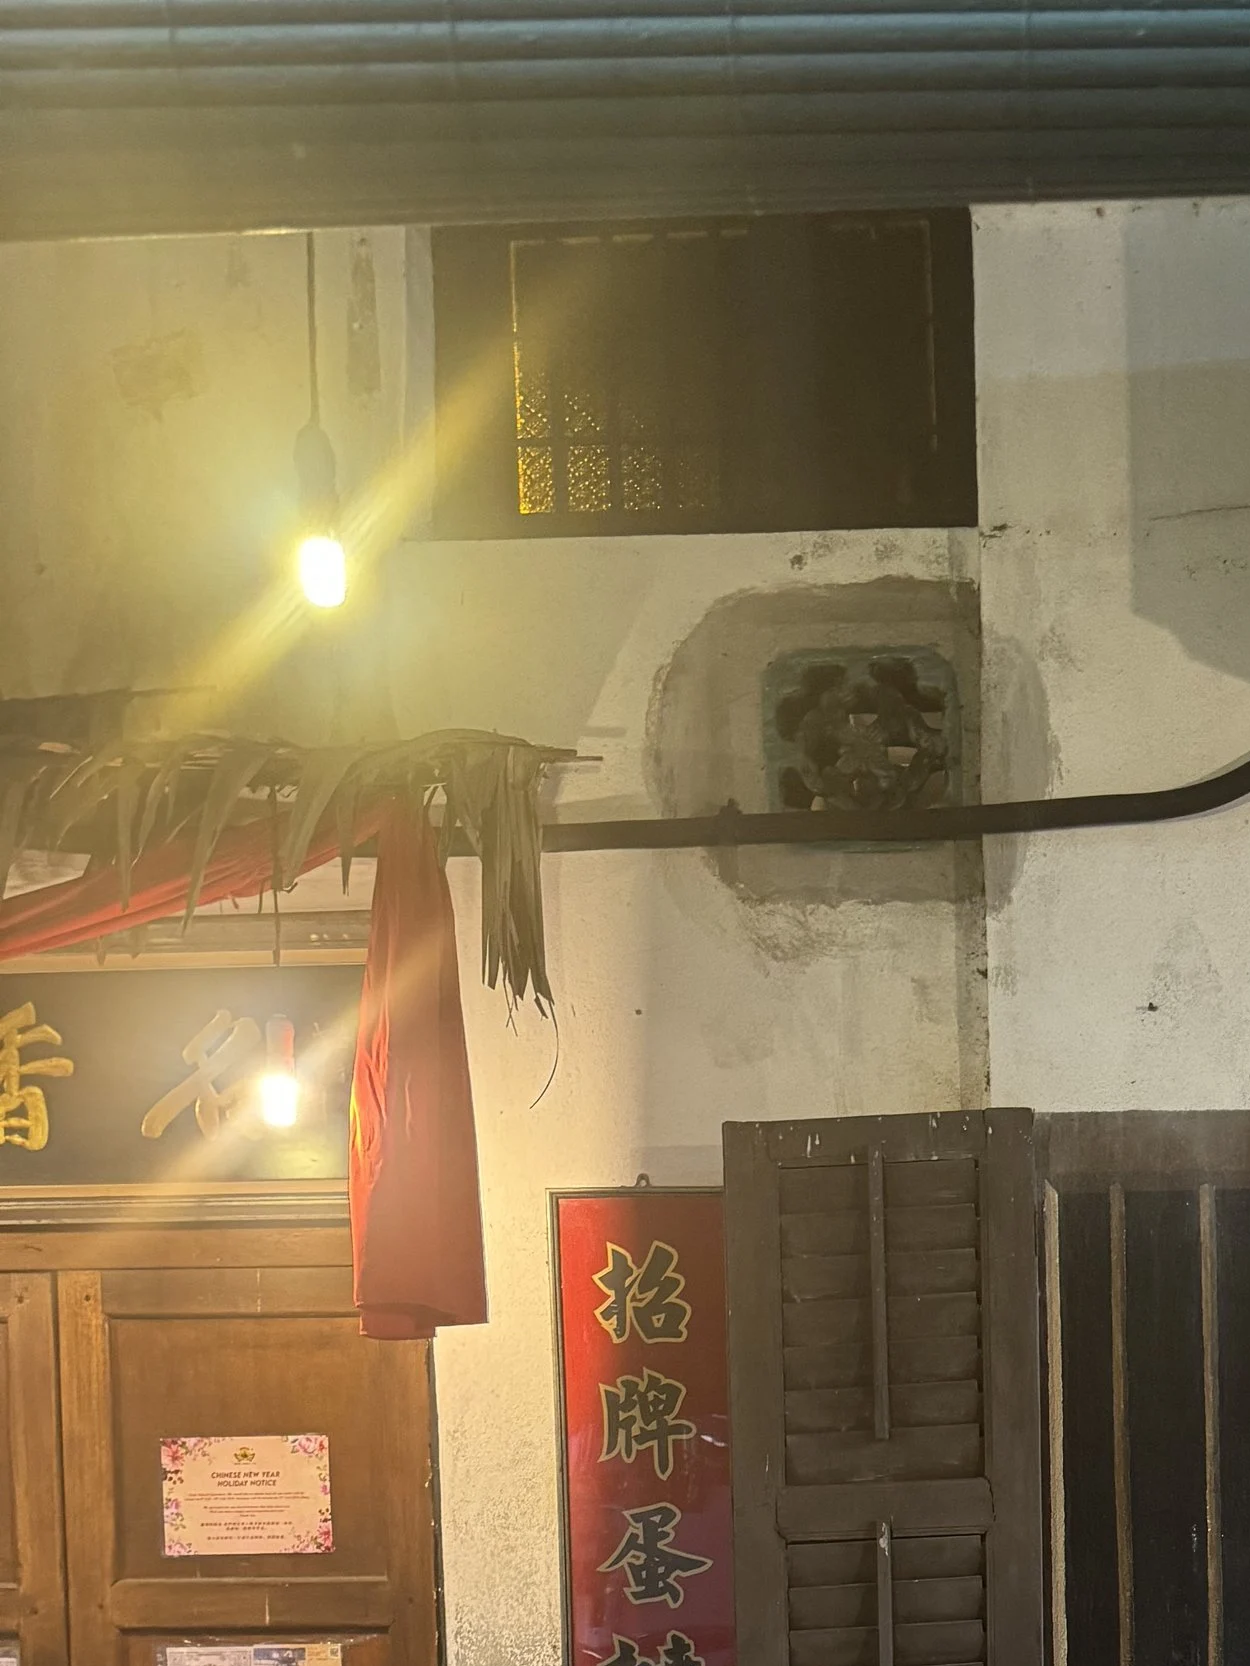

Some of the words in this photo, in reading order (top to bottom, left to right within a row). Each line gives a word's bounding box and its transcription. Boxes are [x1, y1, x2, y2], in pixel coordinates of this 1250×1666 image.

[210, 1471, 241, 1479] CHINESE
[243, 1471, 260, 1479] NEW
[261, 1470, 281, 1478] YEAR
[217, 1479, 248, 1487] HOLIDAY
[250, 1479, 277, 1487] NOTICE
